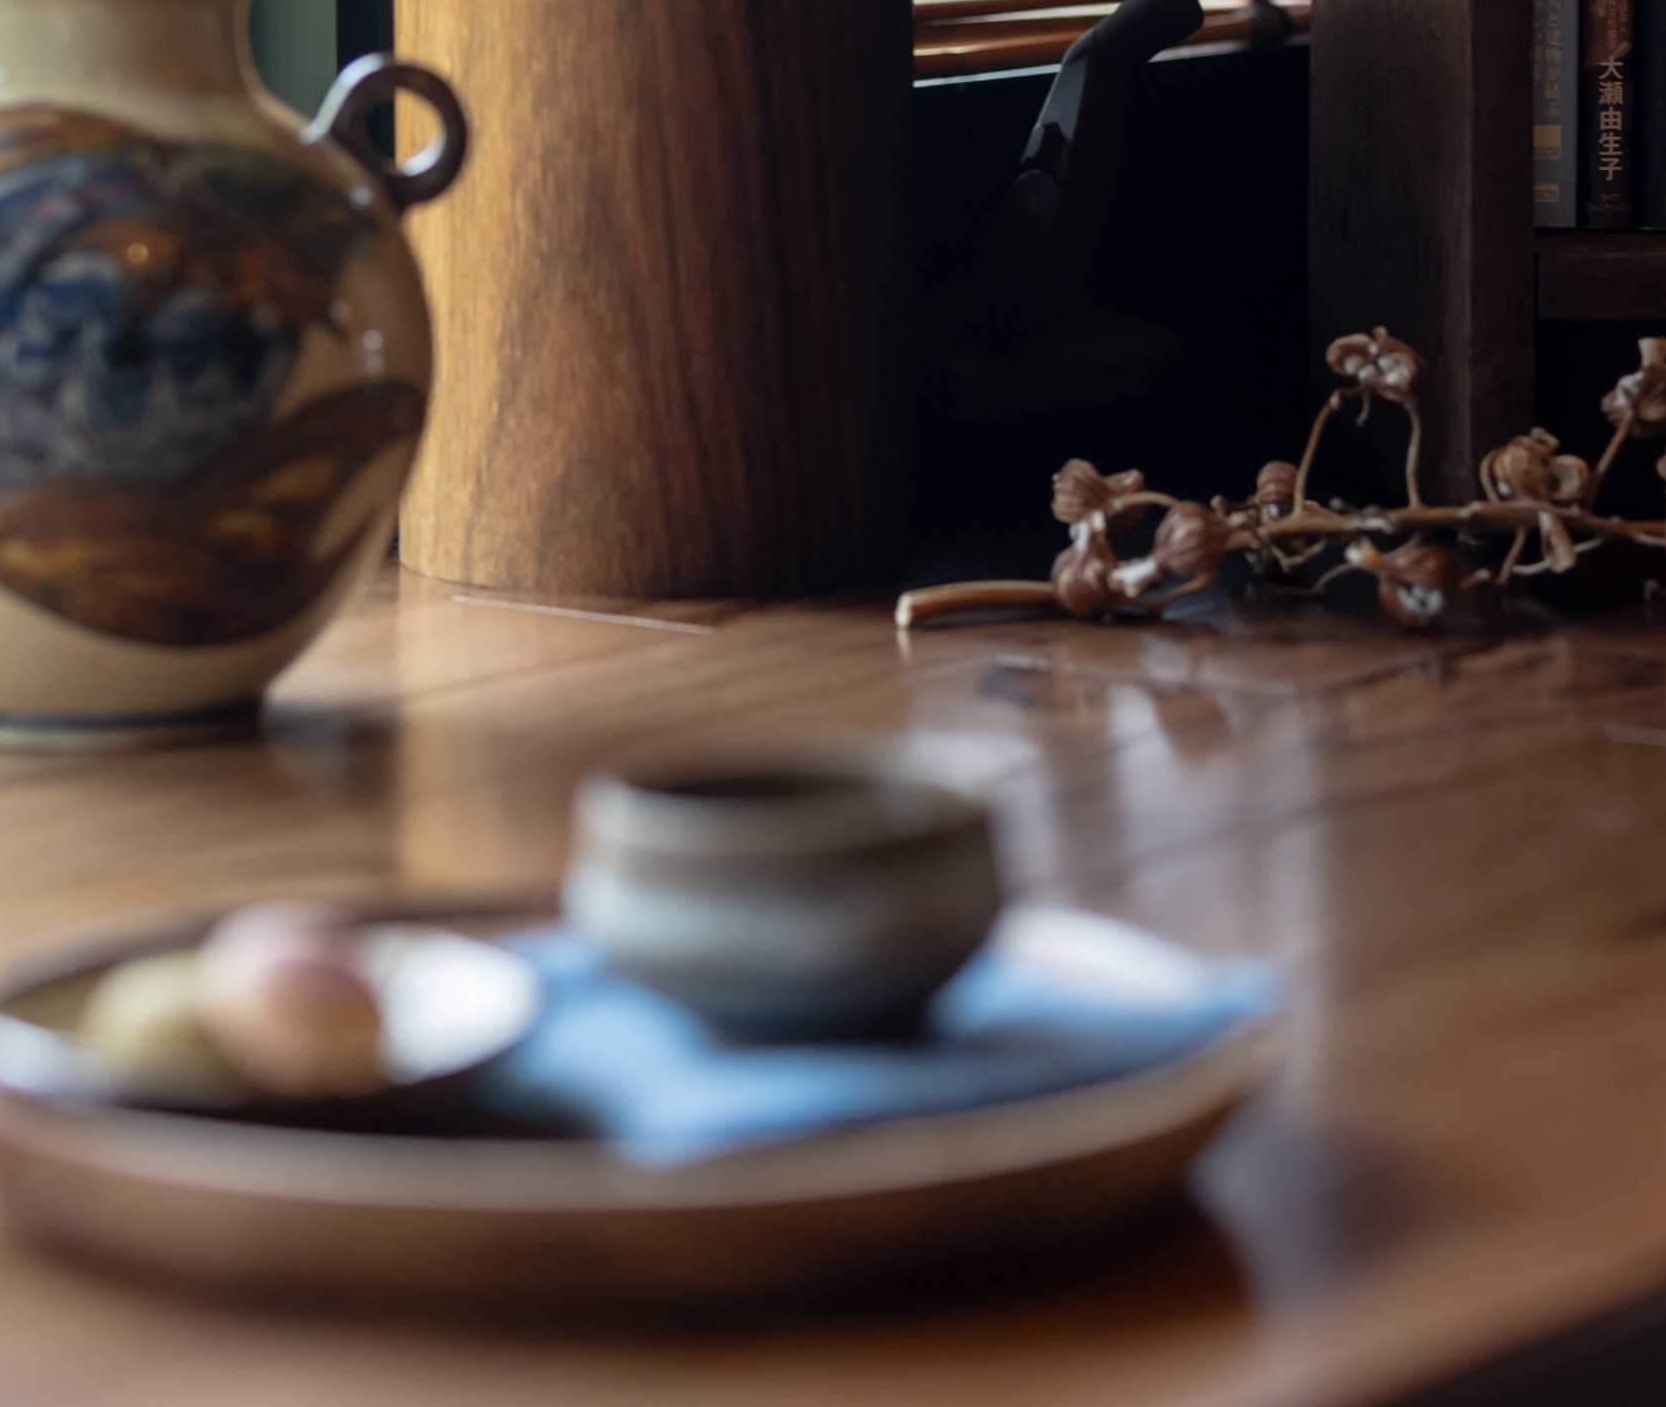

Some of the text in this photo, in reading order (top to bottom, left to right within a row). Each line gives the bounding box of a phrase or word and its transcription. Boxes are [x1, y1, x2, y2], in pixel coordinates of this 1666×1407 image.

[1597, 55, 1625, 182] 大瀬由生子
